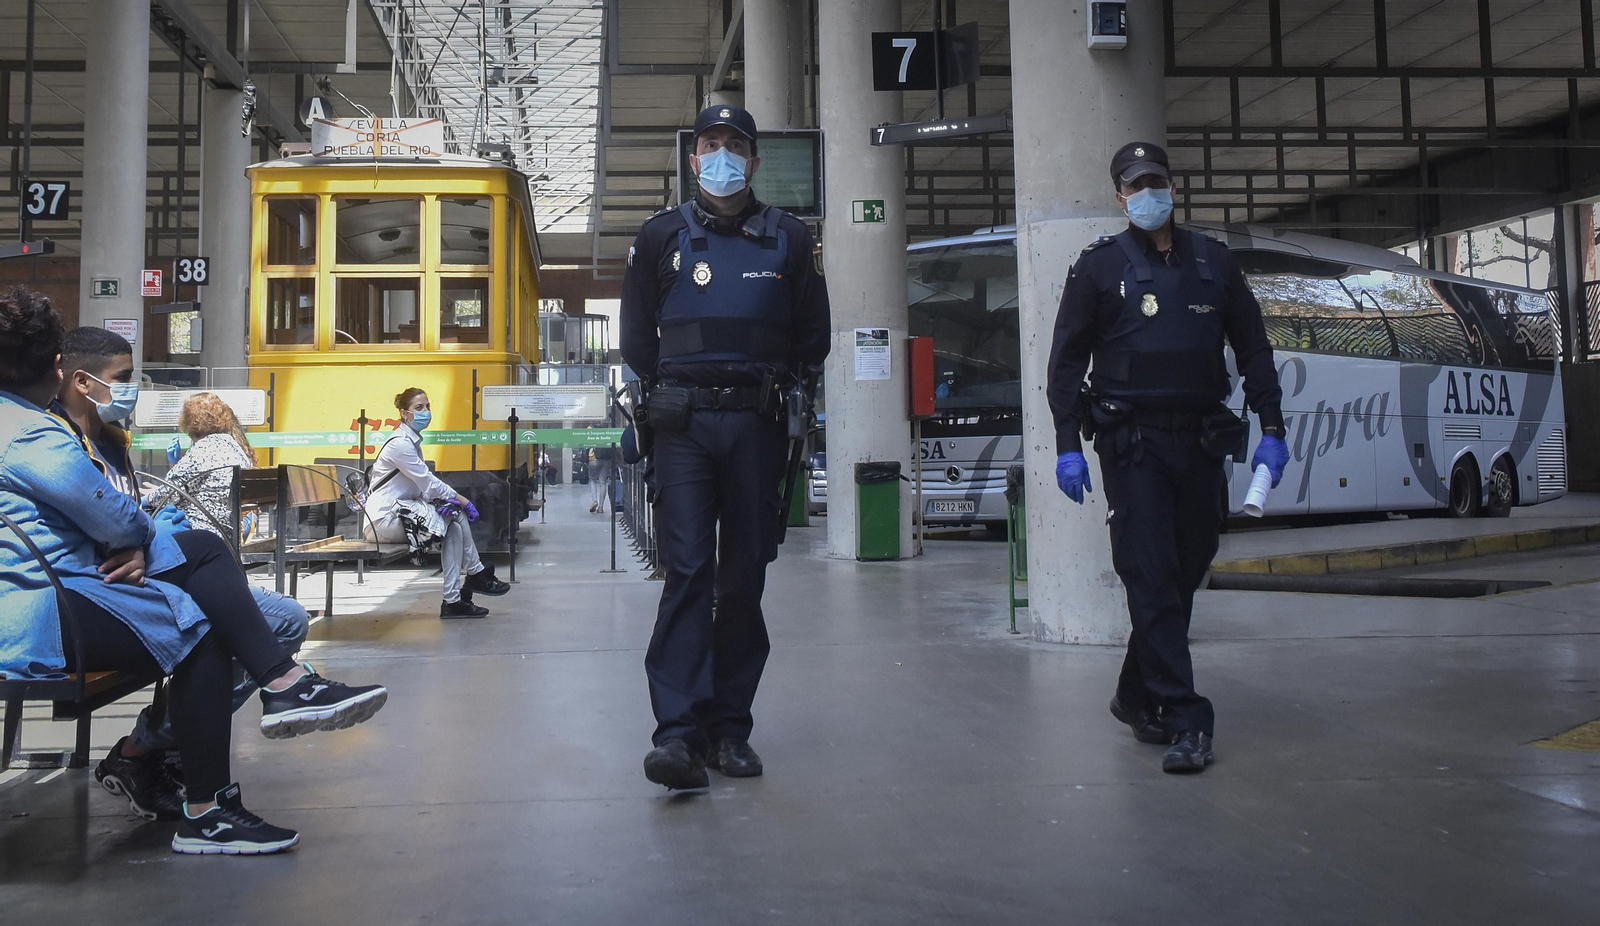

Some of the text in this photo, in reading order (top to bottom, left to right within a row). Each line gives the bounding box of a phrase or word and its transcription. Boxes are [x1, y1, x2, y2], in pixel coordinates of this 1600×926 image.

[892, 38, 917, 83] 7
[305, 97, 326, 125] A
[346, 119, 408, 130] SEVILLA
[356, 132, 401, 142] CORIA
[877, 128, 886, 143] 7
[324, 145, 431, 156] PUEBLA DEL RIO
[26, 183, 66, 215] 37
[178, 258, 207, 282] 38
[742, 271, 777, 279] POLICIA
[1443, 370, 1515, 416] ALSA
[911, 440, 947, 460] SA
[935, 502, 973, 512] 8212 HKN
